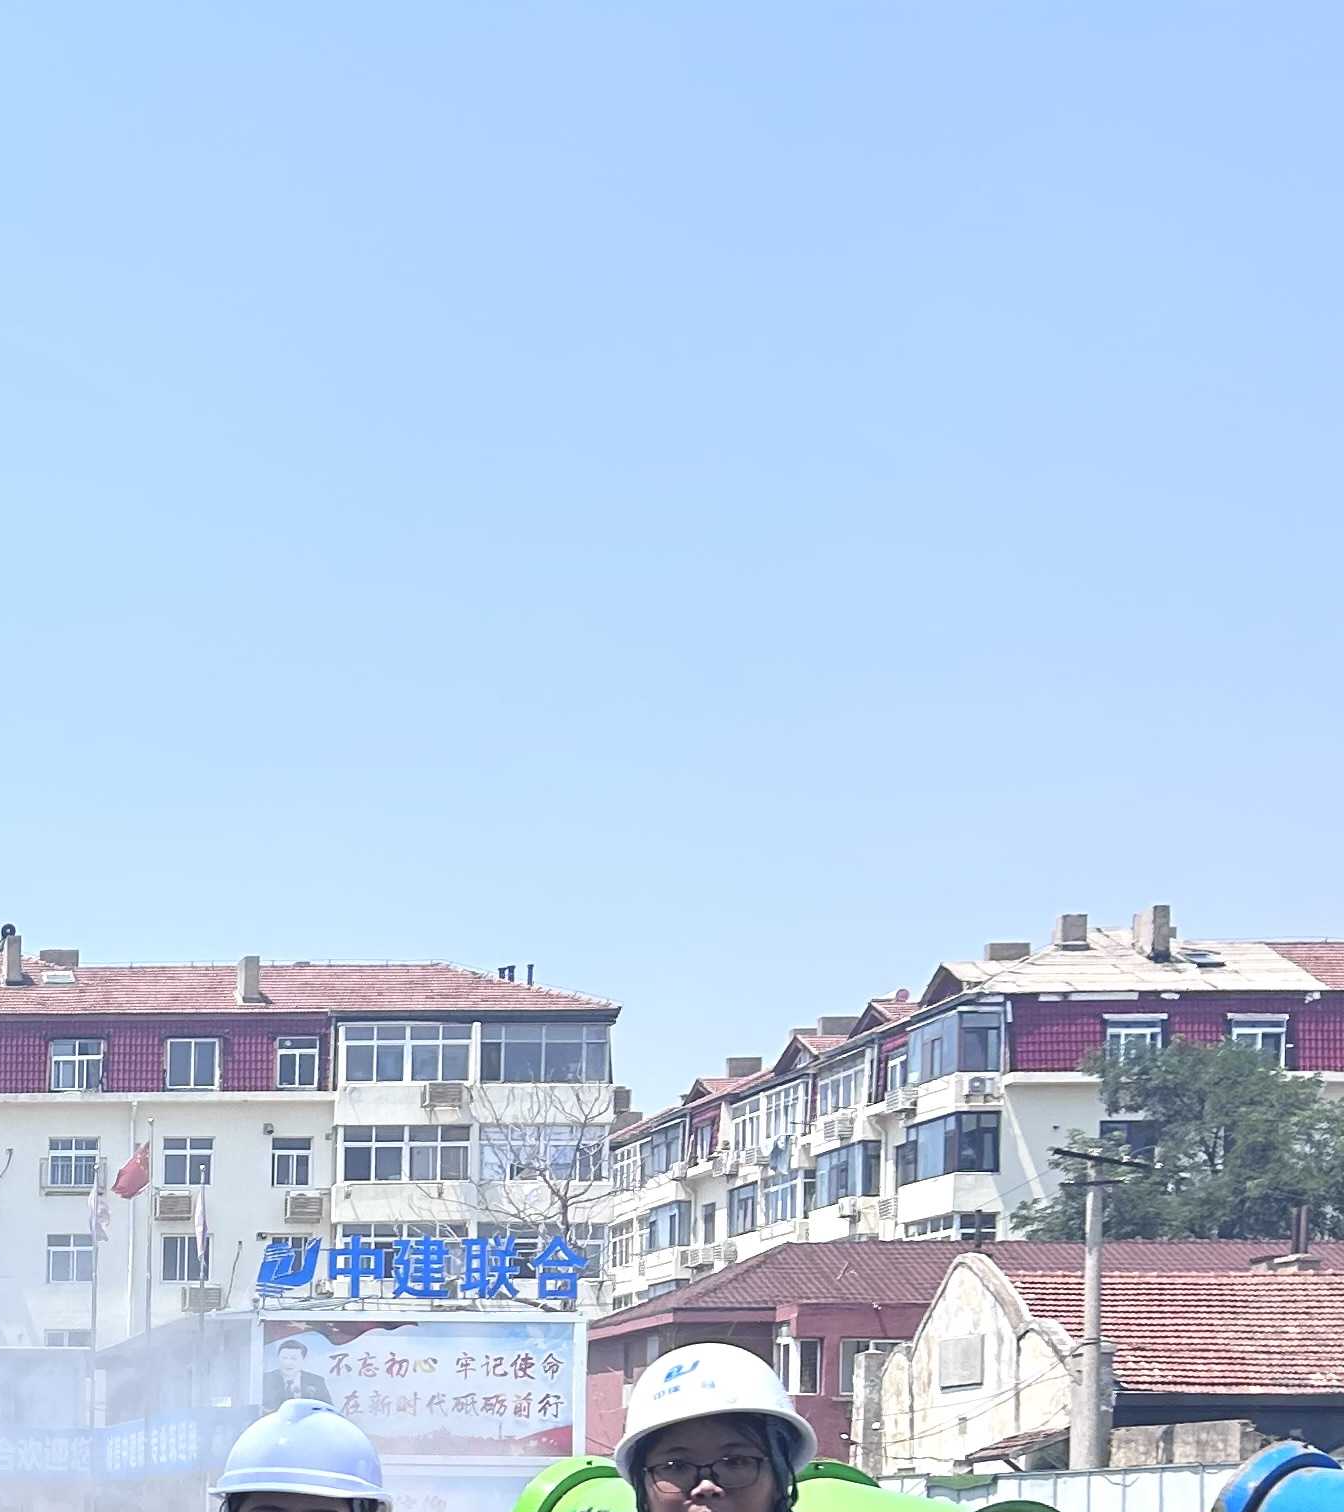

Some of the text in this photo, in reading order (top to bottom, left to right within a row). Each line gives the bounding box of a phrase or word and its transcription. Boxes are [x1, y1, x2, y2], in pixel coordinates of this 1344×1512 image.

[329, 1234, 589, 1299] 中建联合
[328, 1351, 565, 1382] 不忘初心 牢记使命
[341, 1390, 565, 1420] 在新时代砥砺前行
